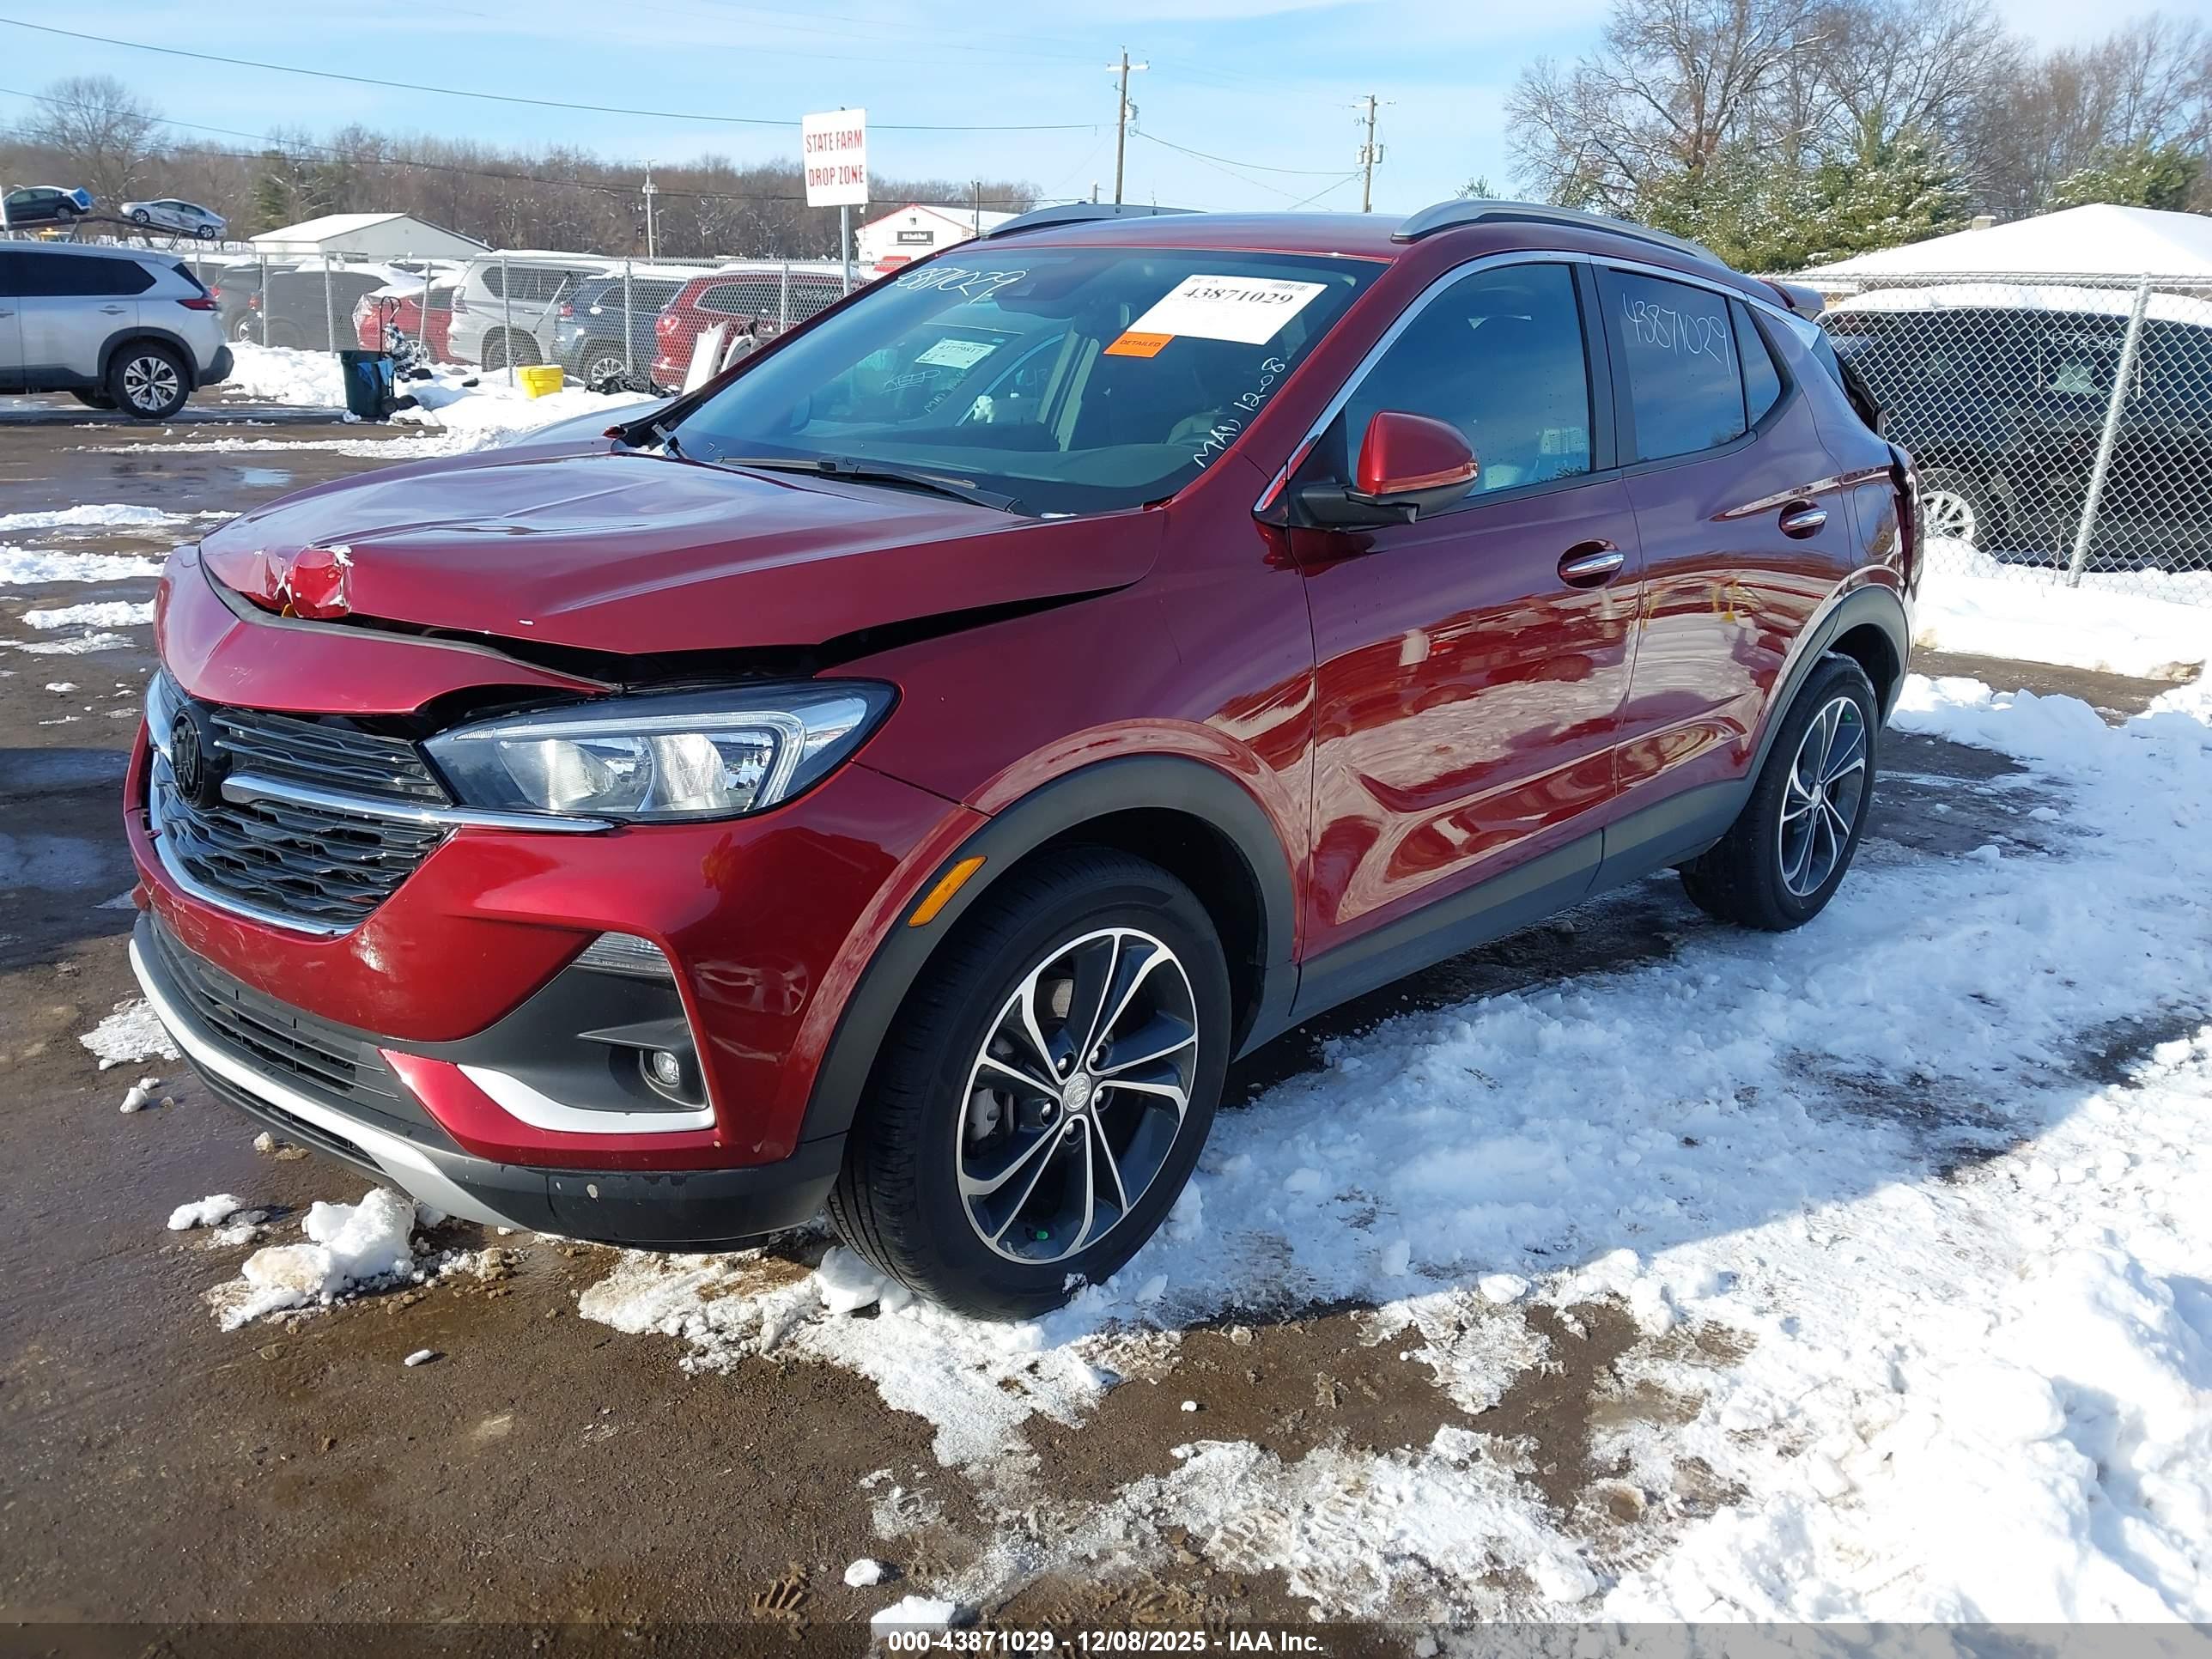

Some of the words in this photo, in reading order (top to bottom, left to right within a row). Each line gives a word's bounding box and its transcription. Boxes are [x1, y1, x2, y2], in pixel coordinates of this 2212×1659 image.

[806, 131, 834, 153] STATE
[836, 129, 862, 150] FARM
[809, 167, 836, 186] DROP
[838, 165, 864, 185] ZONE
[1183, 287, 1293, 304] 43871029
[1119, 339, 1162, 349] DETAILED
[1622, 293, 1732, 377] 43871029
[1233, 357, 1285, 412] 12-08
